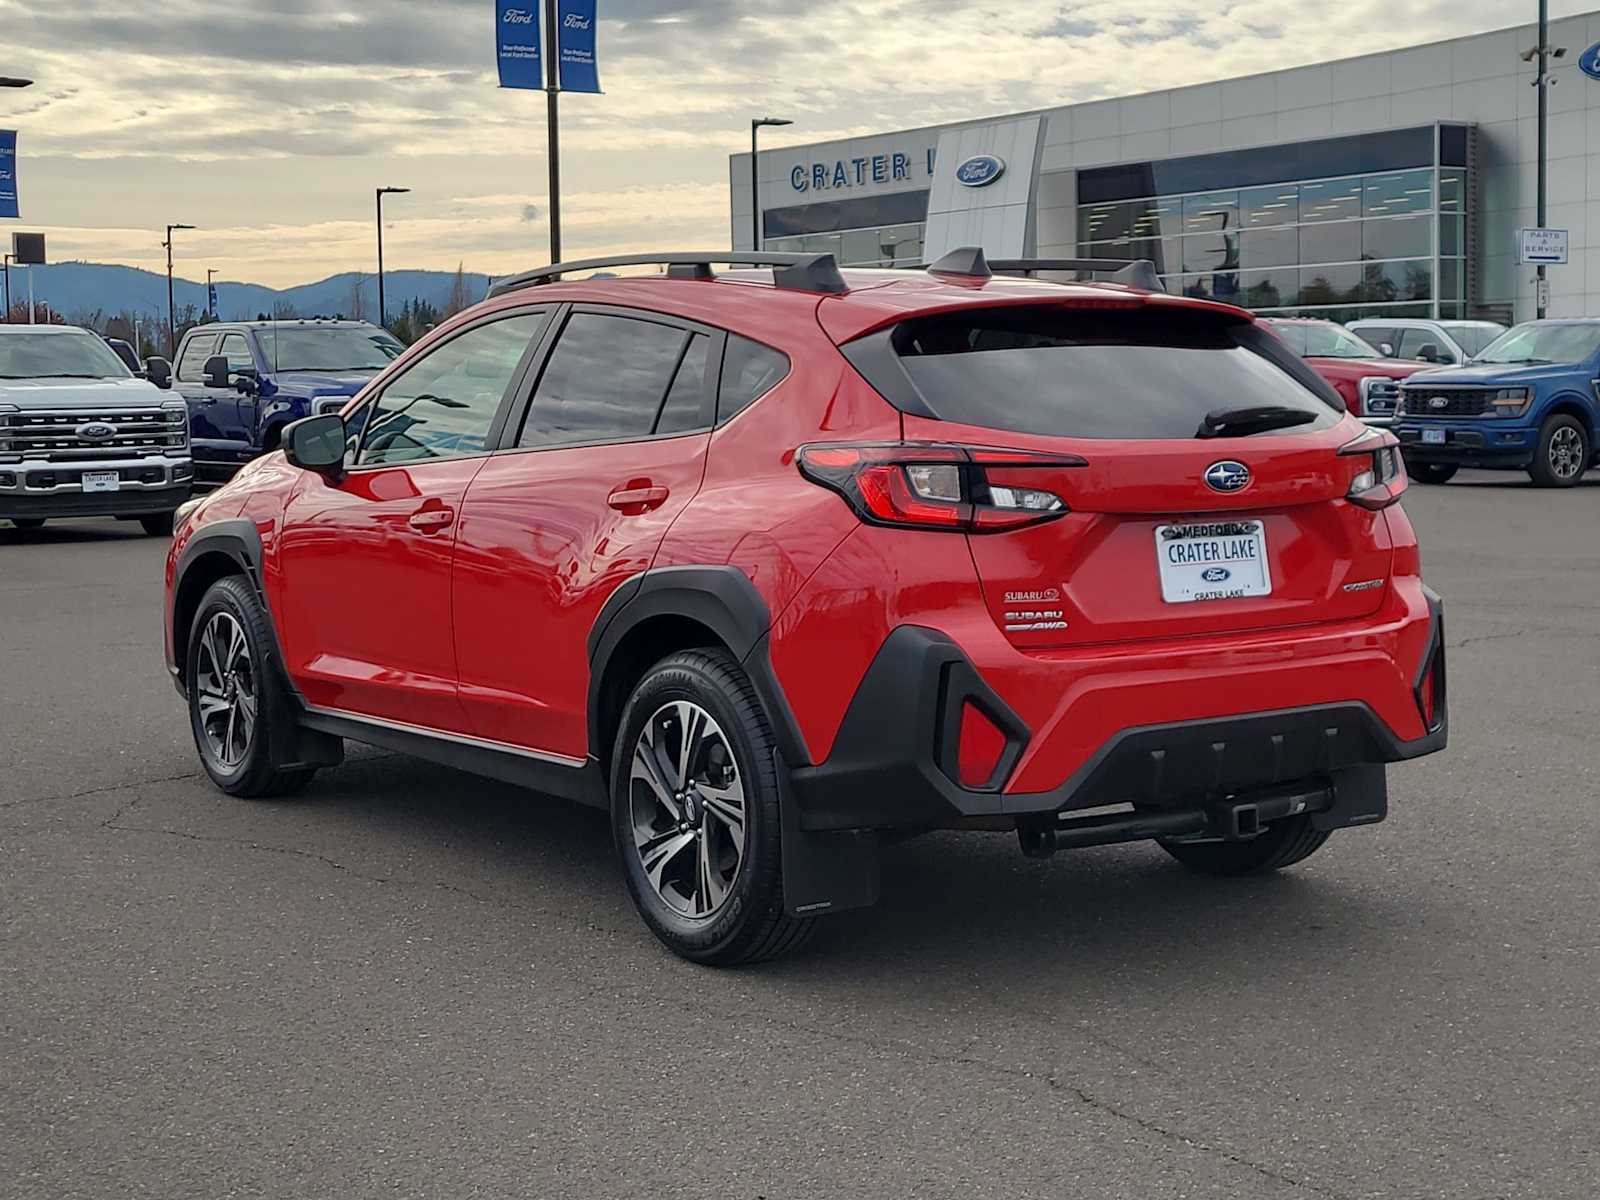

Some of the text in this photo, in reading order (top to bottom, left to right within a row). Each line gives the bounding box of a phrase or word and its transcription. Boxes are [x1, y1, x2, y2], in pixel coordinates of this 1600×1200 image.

[503, 9, 533, 24] Ford
[563, 14, 590, 29] Ford
[791, 153, 907, 192] CRATER
[1182, 524, 1239, 538] MEDFORD
[1168, 539, 1256, 563] CRATER LAKE
[1004, 591, 1043, 600] SUBARU
[1194, 589, 1244, 600] CRATER LAKE
[1005, 610, 1063, 620] SUBARU
